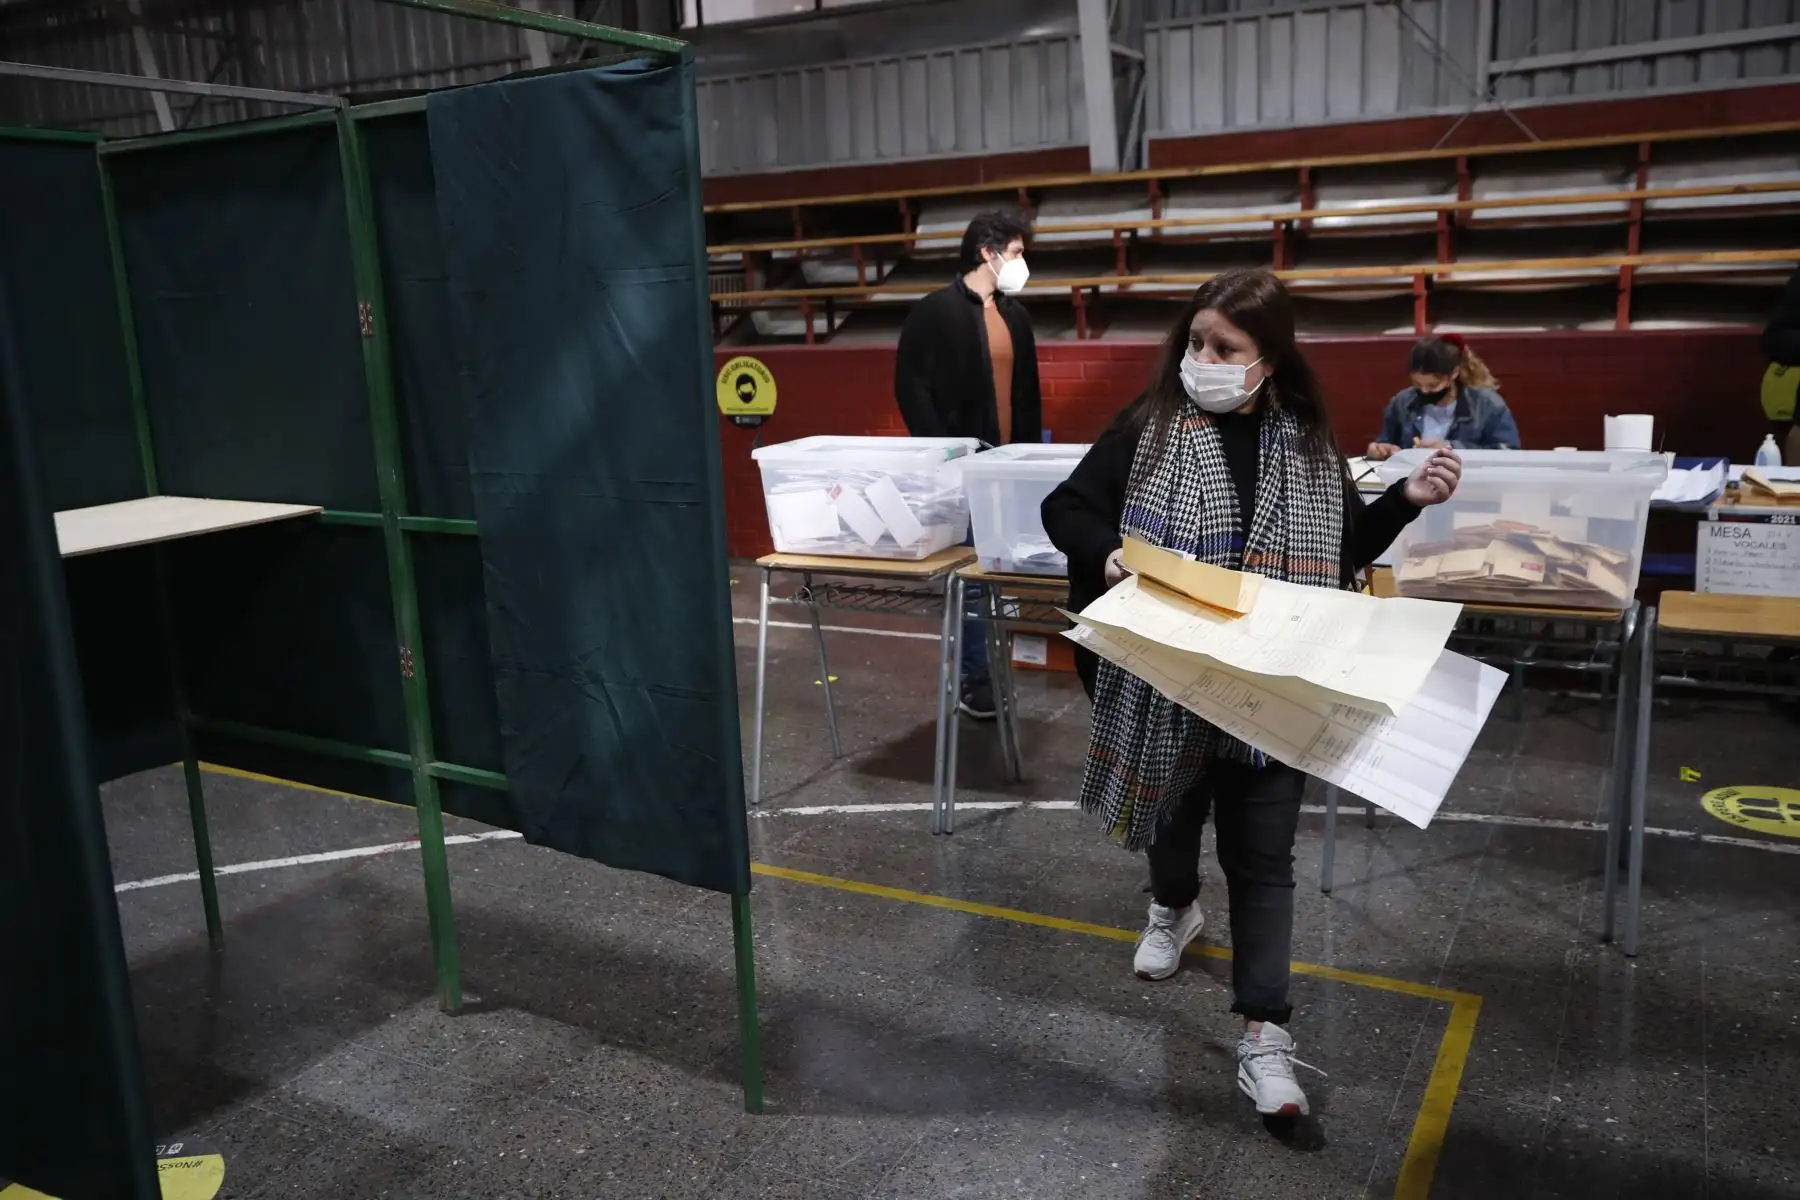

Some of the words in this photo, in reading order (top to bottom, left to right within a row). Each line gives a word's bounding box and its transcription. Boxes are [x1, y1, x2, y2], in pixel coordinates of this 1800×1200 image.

[1770, 515, 1796, 524] 2021
[1710, 526, 1752, 538] MESA
[1733, 541, 1787, 550] VOCALES
[157, 1161, 203, 1171] #NosS
